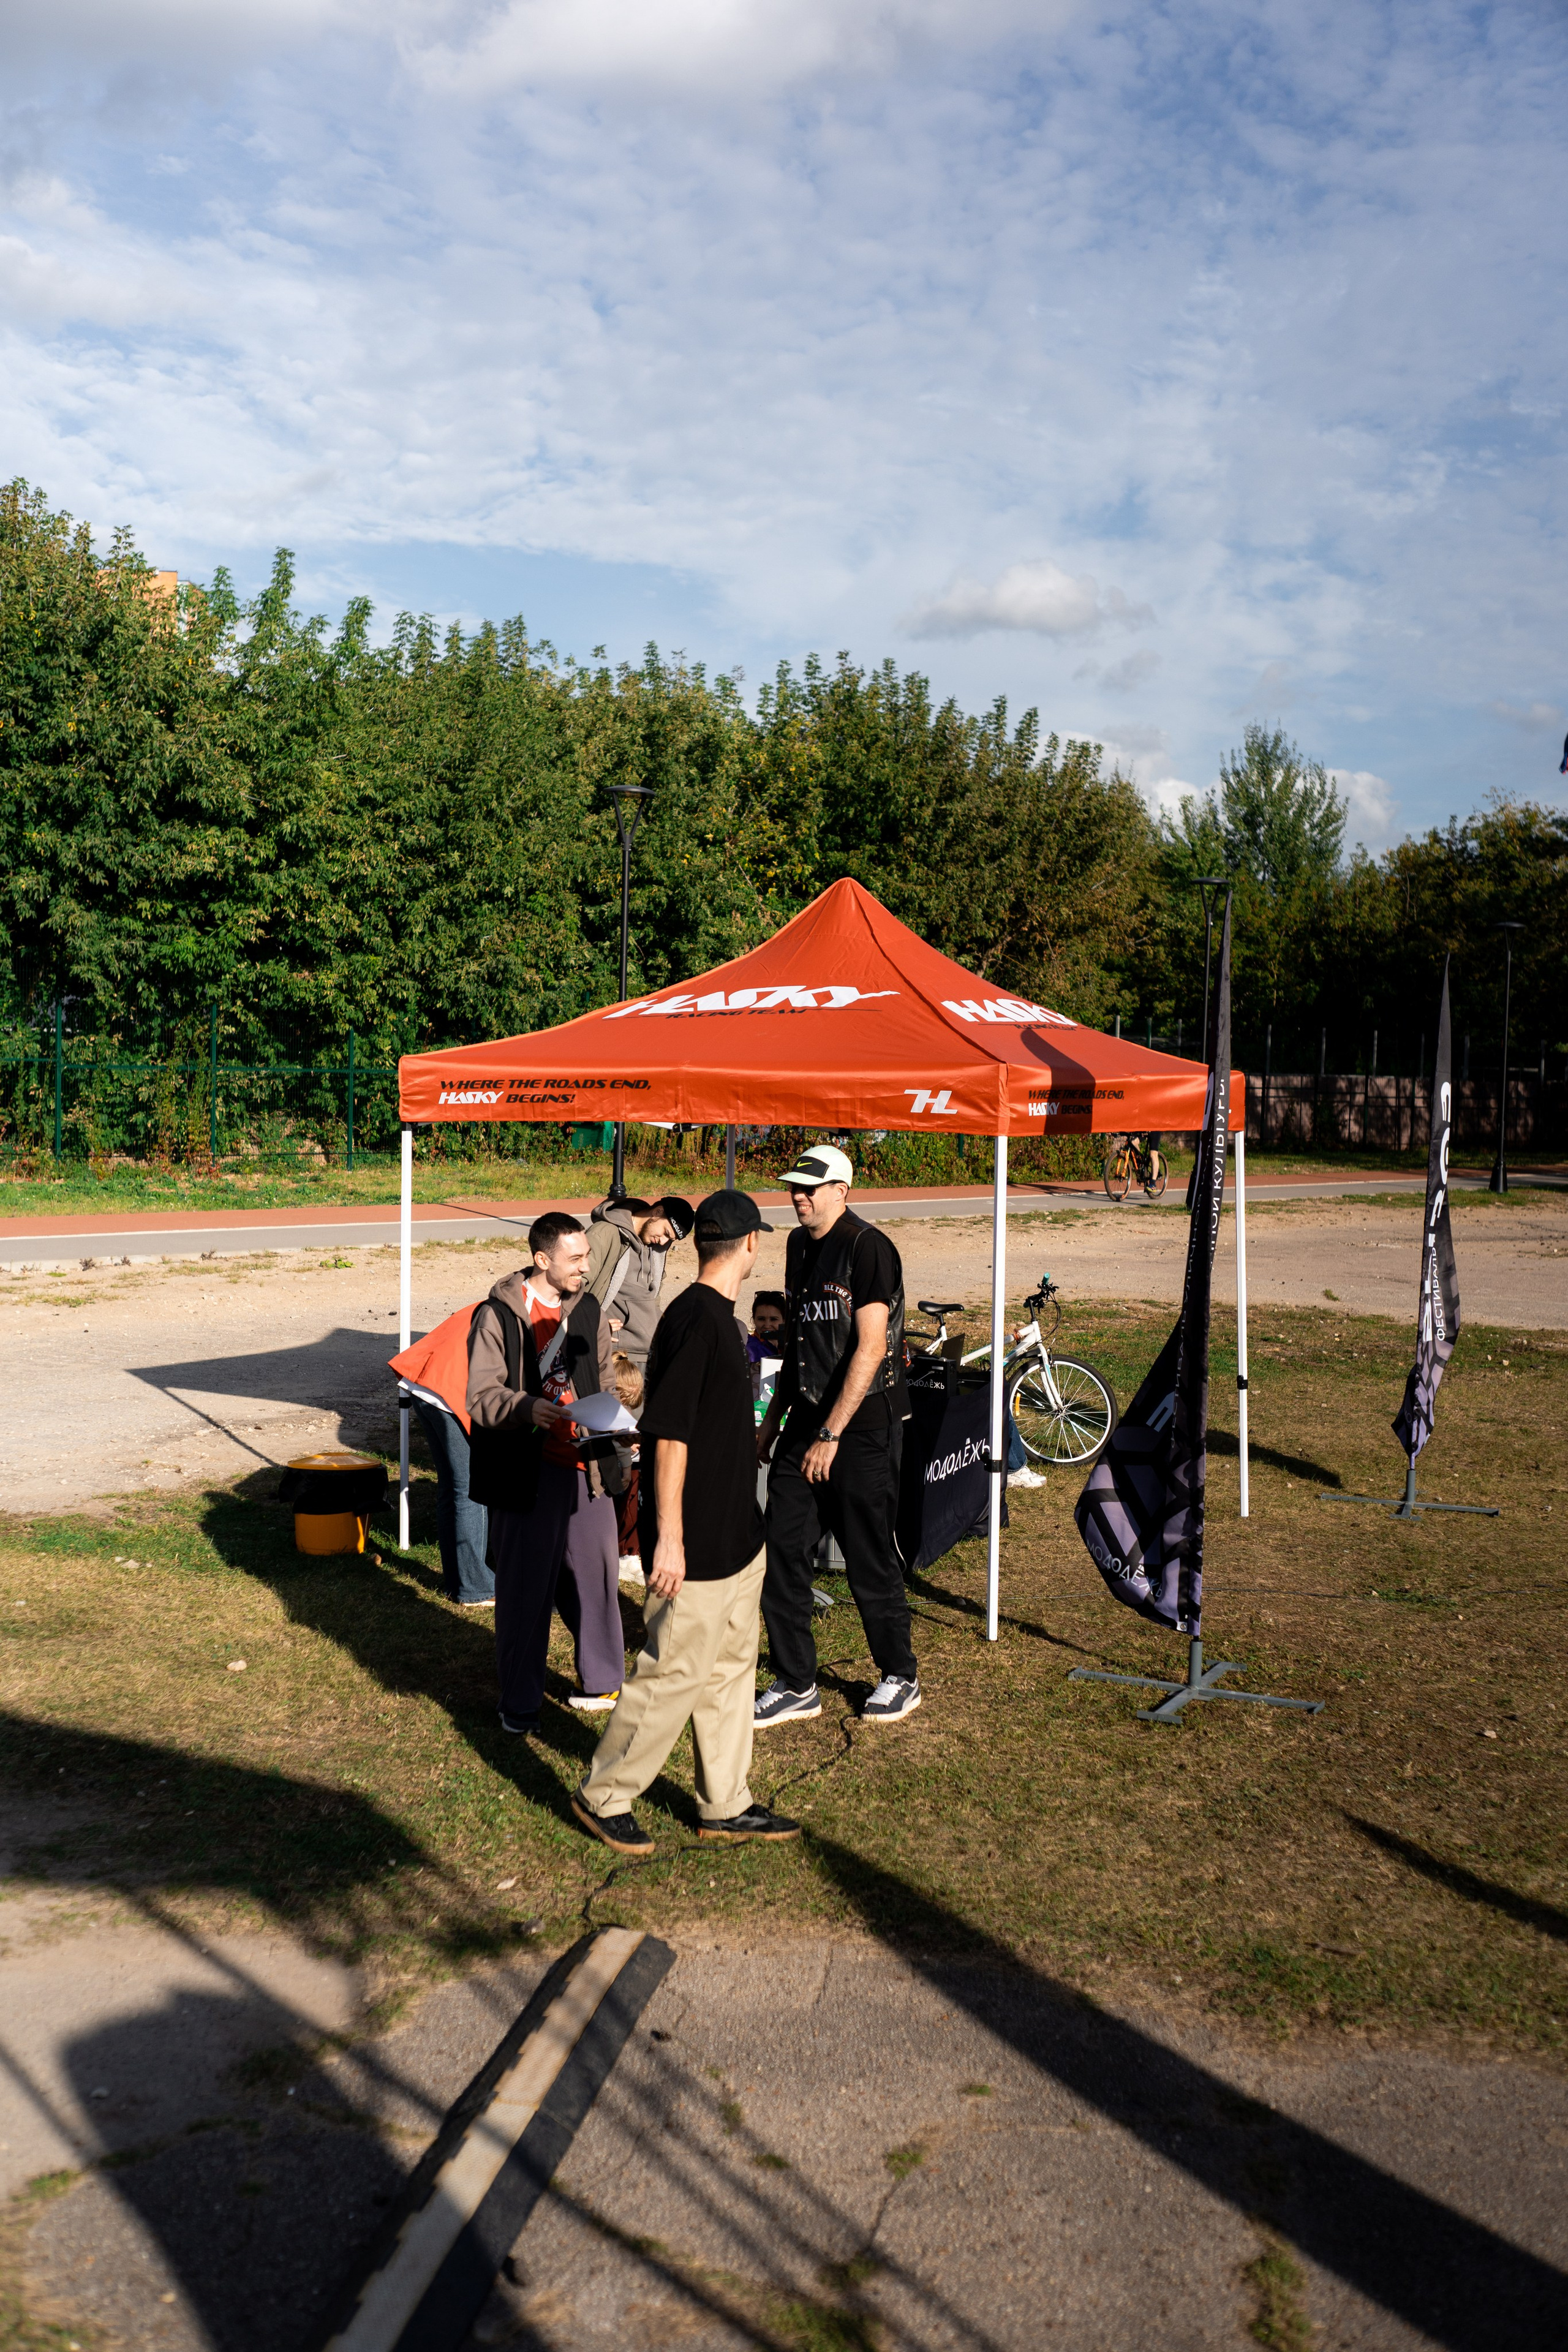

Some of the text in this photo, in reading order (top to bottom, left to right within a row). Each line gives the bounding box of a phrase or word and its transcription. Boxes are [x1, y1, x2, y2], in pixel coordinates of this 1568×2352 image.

[602, 985, 900, 1020] HASKY
[665, 1009, 745, 1019] RACING
[940, 998, 1079, 1027] HASKY
[440, 1079, 652, 1090] WHERE THE ROADS END,
[438, 1091, 576, 1104] HASKY BEGINS!
[1028, 1090, 1125, 1100] WHERE THE ROADS END,
[1028, 1102, 1060, 1117] HASKY
[802, 1300, 839, 1322] XXIII
